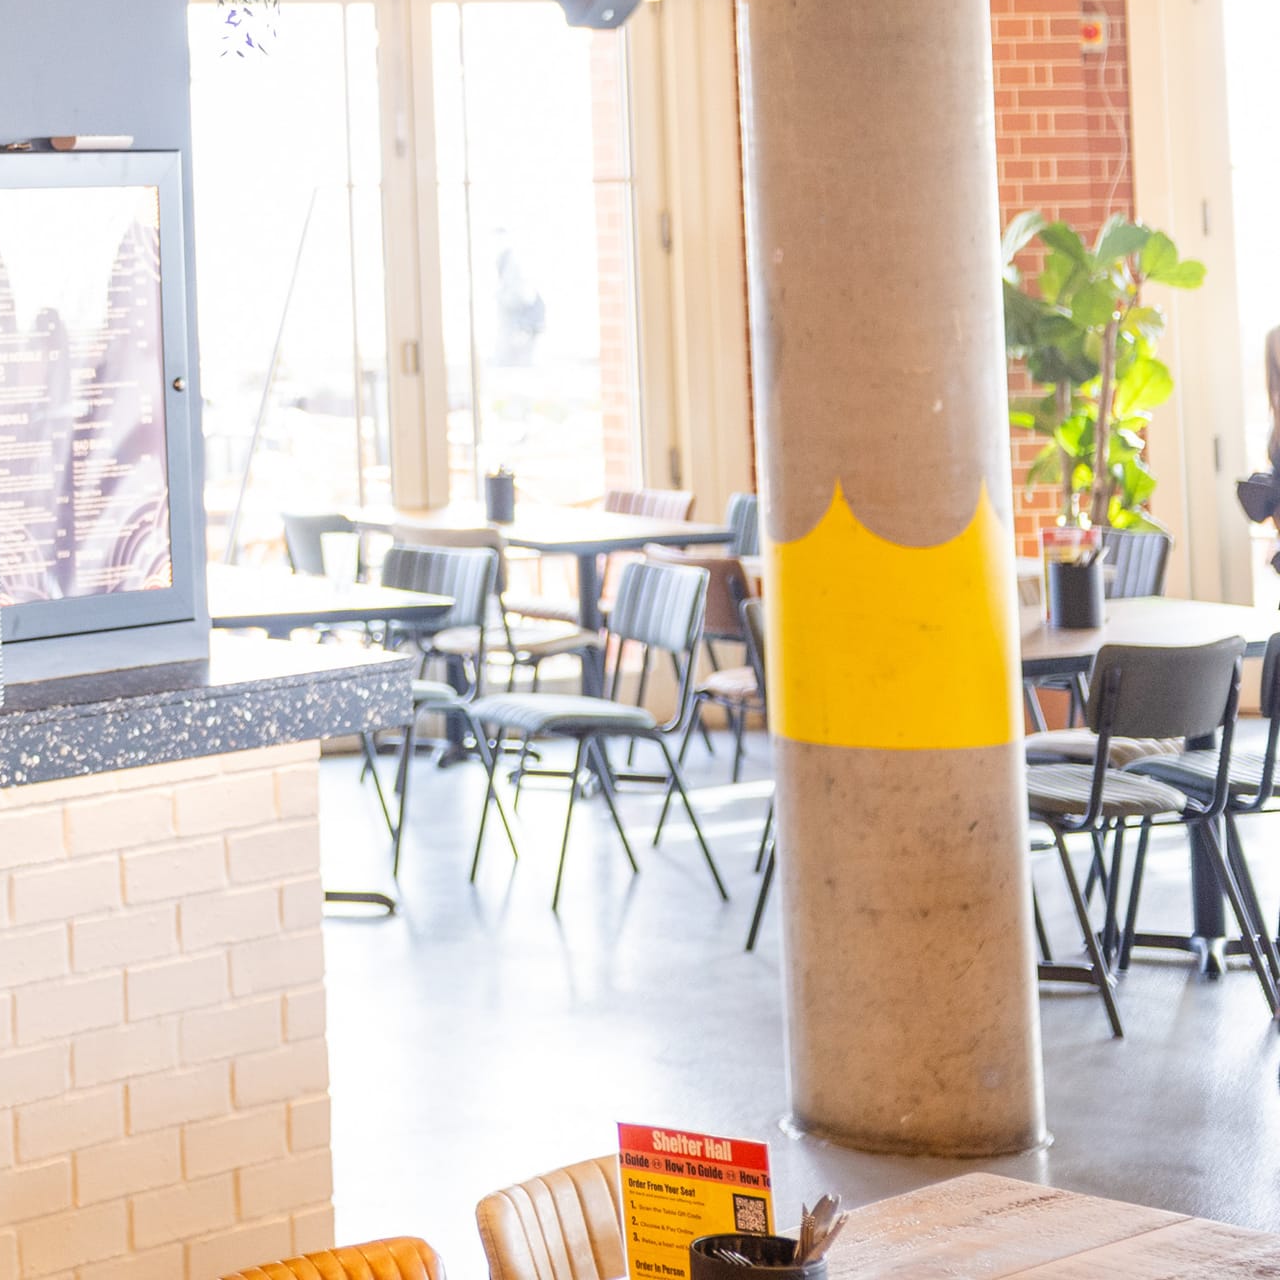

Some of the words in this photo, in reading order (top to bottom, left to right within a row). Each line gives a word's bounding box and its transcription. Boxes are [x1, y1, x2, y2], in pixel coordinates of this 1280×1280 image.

[651, 1130, 702, 1157] Shelter
[704, 1138, 732, 1162] Hall
[625, 1154, 649, 1168] Guide
[665, 1159, 684, 1174] How
[686, 1162, 697, 1175] To
[698, 1164, 723, 1179] Guide
[740, 1171, 759, 1186] How
[628, 1178, 646, 1189] Order
[647, 1181, 663, 1192] From
[665, 1184, 679, 1195] Your
[680, 1186, 695, 1197] Seat
[635, 1260, 653, 1271] Order
[654, 1263, 661, 1273] In
[662, 1264, 685, 1277] Person
